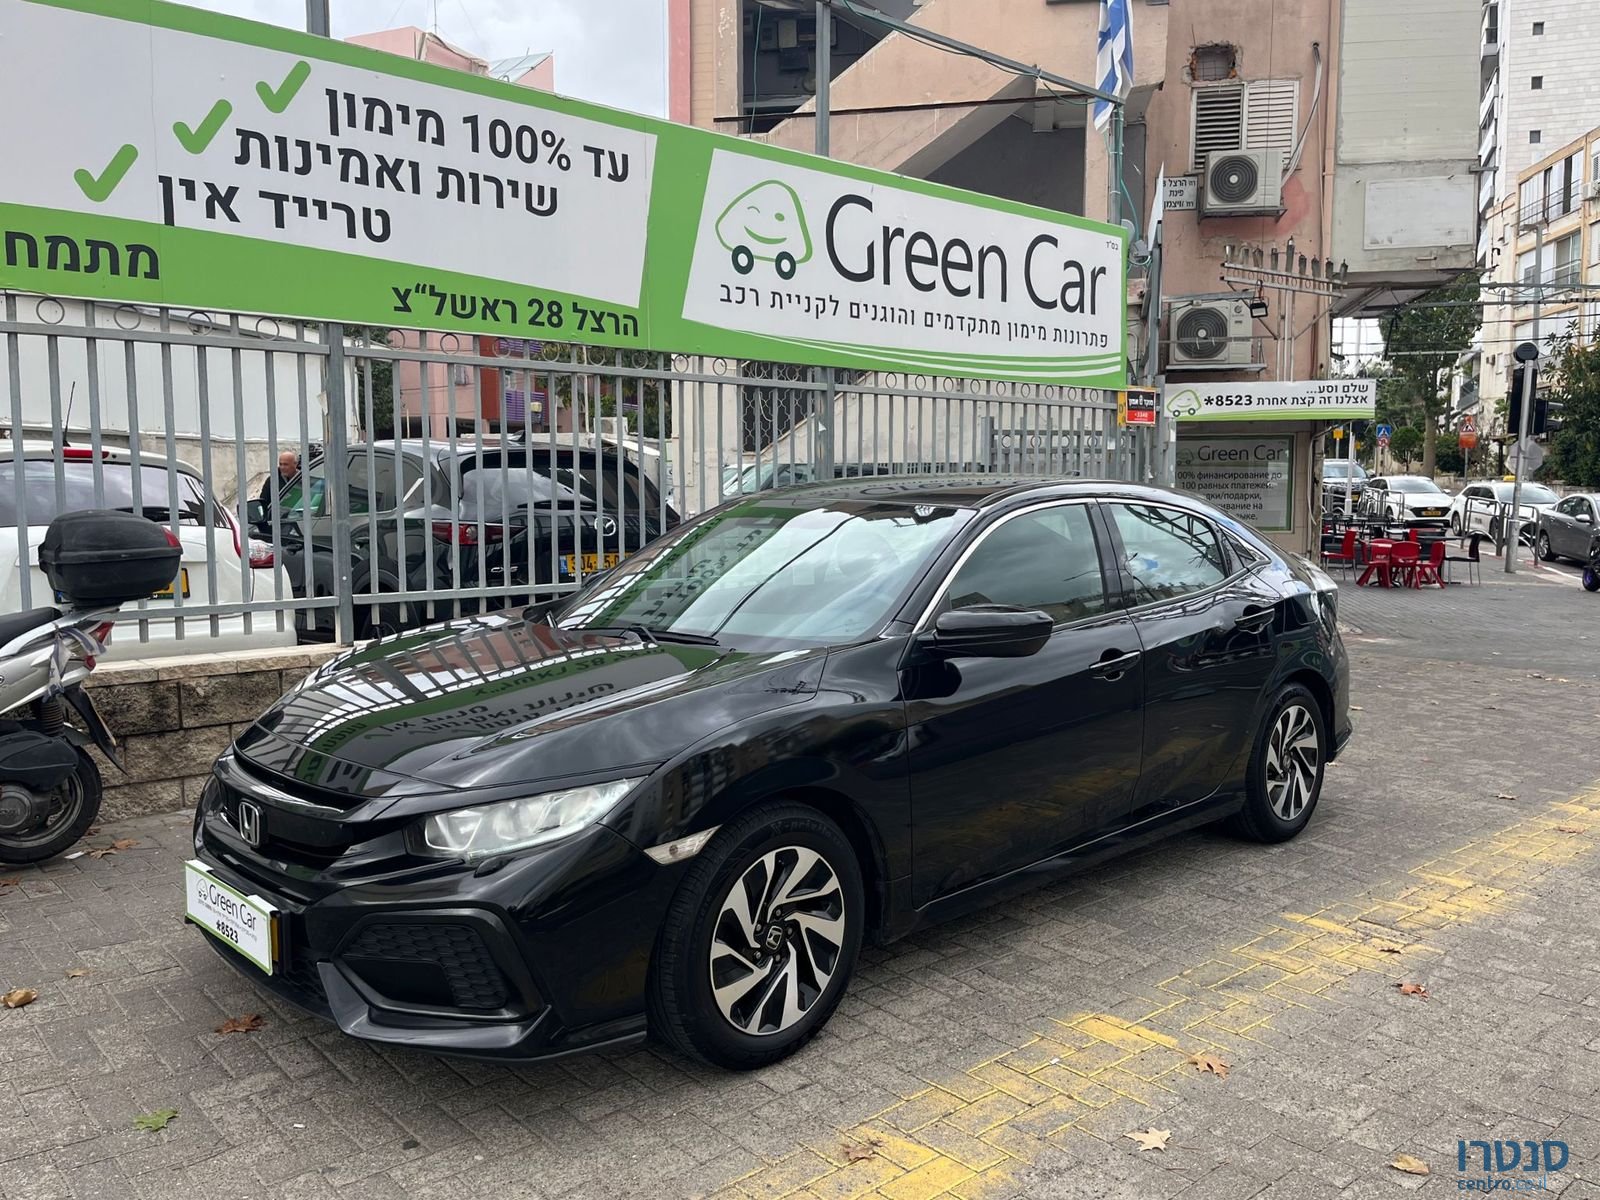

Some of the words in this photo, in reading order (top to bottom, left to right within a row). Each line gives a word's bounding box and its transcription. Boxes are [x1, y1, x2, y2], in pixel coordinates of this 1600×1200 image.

[325, 87, 445, 146] מימון
[463, 113, 571, 171] 100%
[235, 127, 421, 195] ואמינות
[584, 143, 629, 183] עד
[437, 165, 558, 217] שירות
[1168, 178, 1187, 187] הרצל
[1168, 189, 1185, 197] פינת
[158, 175, 240, 226] אין
[259, 189, 391, 243] טרייד
[5, 231, 160, 280] מתמח
[826, 194, 1008, 302] Green
[1024, 234, 1107, 316] Car
[720, 284, 760, 307] רכב
[770, 294, 840, 319] לקניית
[527, 298, 563, 329] 28
[572, 302, 639, 337] הרצל
[849, 301, 916, 327] והוגנים
[924, 311, 1000, 336] מתקדמים
[1007, 321, 1048, 344] מימון
[1053, 326, 1108, 348] פתרונות
[1319, 396, 1332, 405] זה
[1335, 394, 1368, 405] אצלנו
[1343, 383, 1369, 393] שלם
[1256, 396, 1287, 406] אחרת
[1291, 396, 1315, 407] קצת
[1197, 445, 1249, 461] Green
[1254, 444, 1283, 461] Car
[1176, 471, 1195, 480] 00%
[1271, 472, 1282, 480] до
[209, 884, 239, 920] Green
[239, 903, 257, 931] Car
